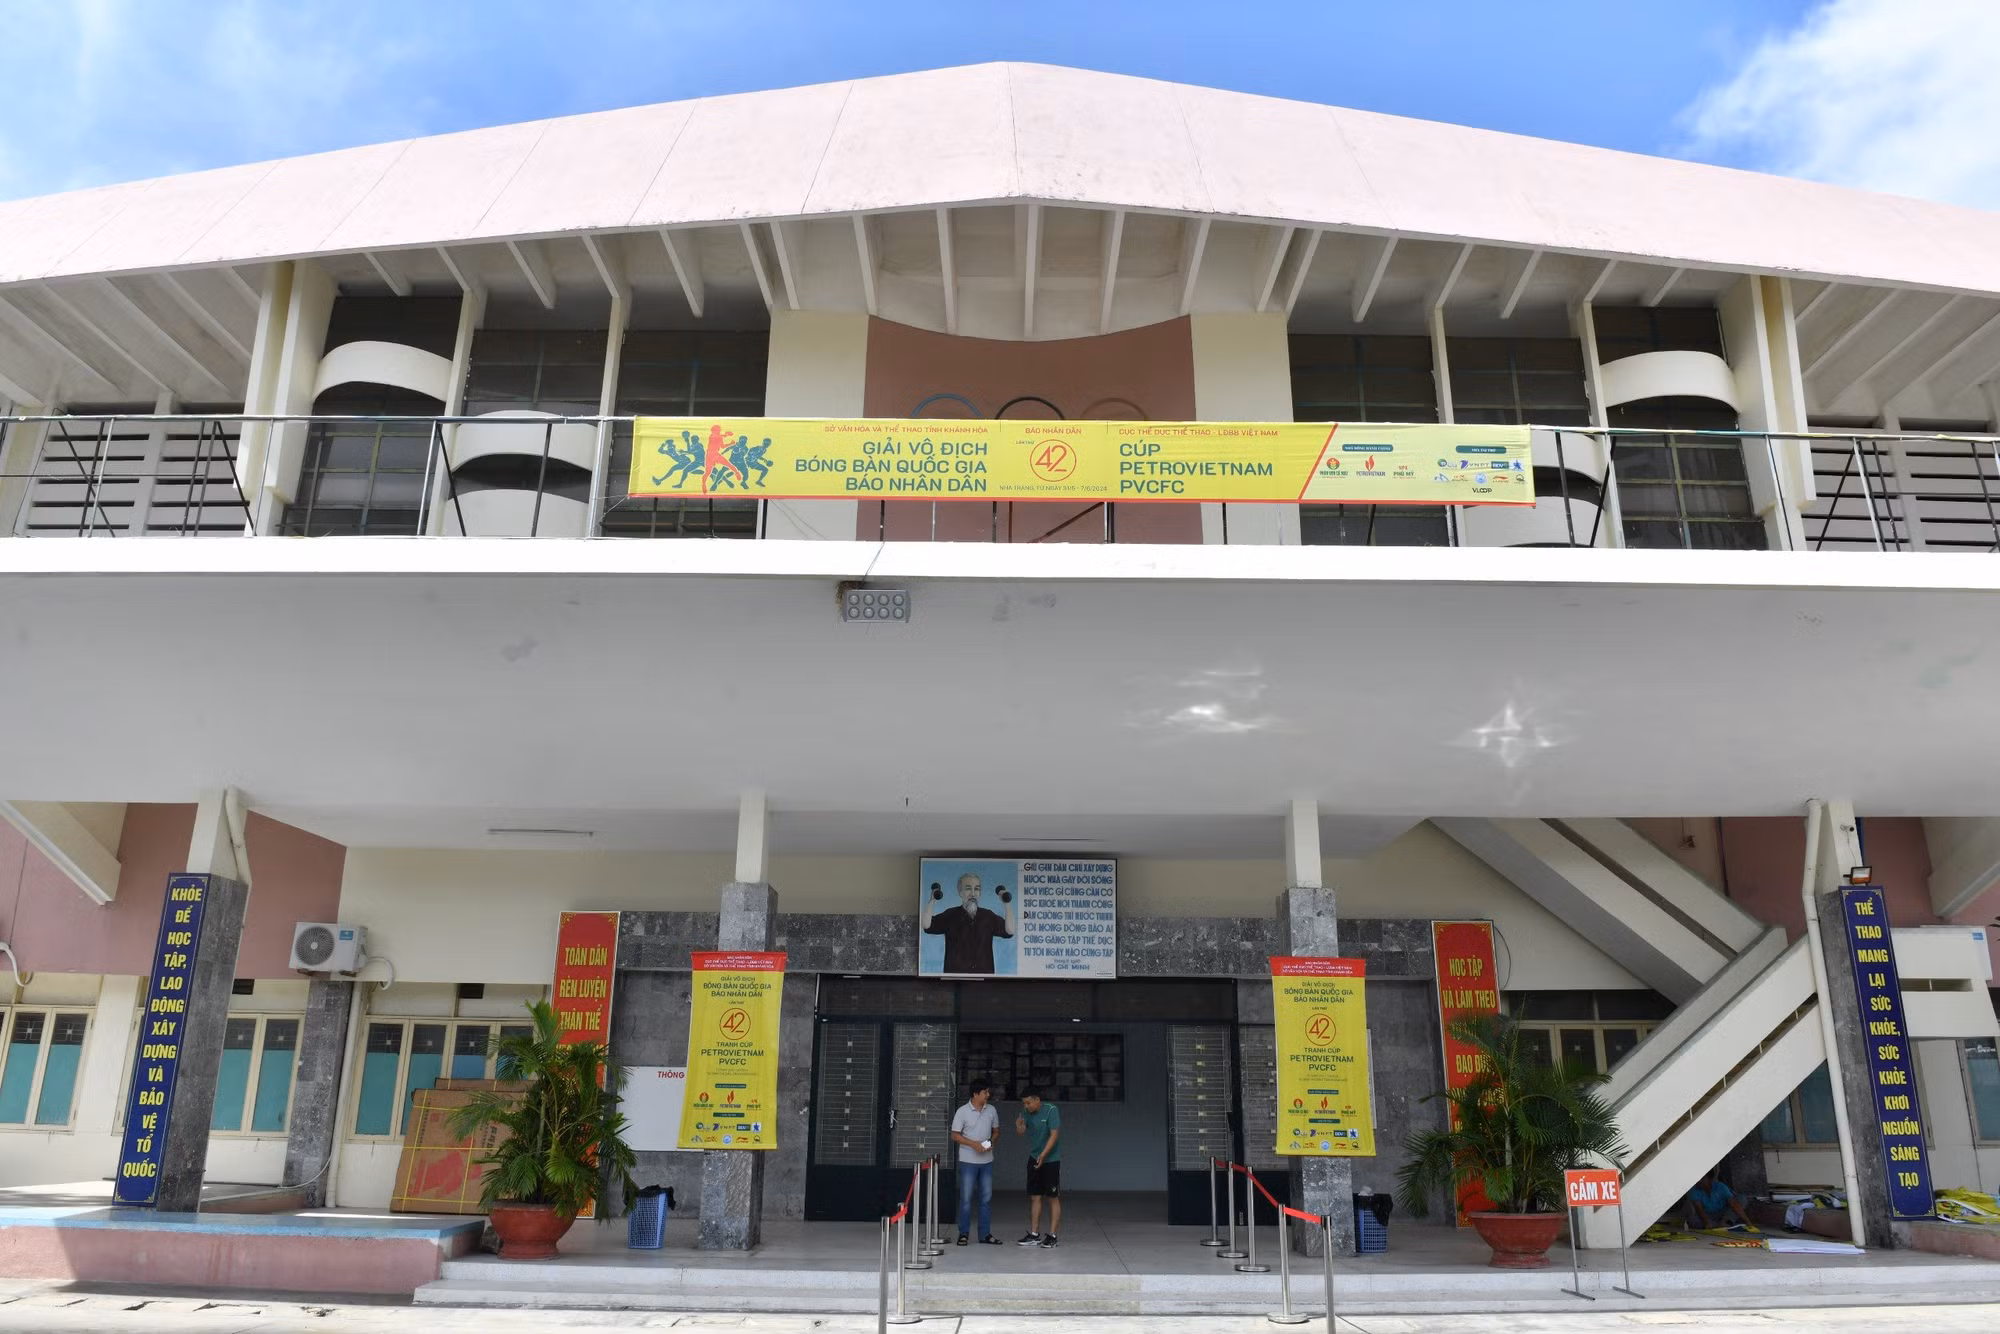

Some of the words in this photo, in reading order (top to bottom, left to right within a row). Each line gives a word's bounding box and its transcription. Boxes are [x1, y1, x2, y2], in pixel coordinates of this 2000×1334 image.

[1066, 427, 1082, 435] DÂN
[863, 437, 900, 455] GIẢI
[909, 438, 934, 456] VÔ
[940, 442, 988, 458] ĐỊCH
[1119, 440, 1162, 457] CÚP
[795, 455, 847, 472] BÓNG
[852, 456, 891, 473] BÀN
[896, 453, 950, 474] QUỐC
[955, 460, 987, 474] GIA
[1034, 444, 1068, 472] 42
[1120, 462, 1273, 476] PETROVIETNAM
[846, 474, 884, 491] BÁO
[889, 474, 942, 492] NHÂN
[948, 474, 987, 492] DÂN
[1120, 480, 1185, 494] PVCFC
[171, 884, 202, 902] KHỎE
[175, 905, 194, 924] ĐỂ
[1854, 896, 1875, 916] THỂ
[167, 931, 192, 948] HỌC
[1855, 925, 1882, 940] THAO
[164, 952, 187, 970] TẬP,
[565, 944, 588, 966] TOÀN
[588, 944, 608, 966] DÂN
[1857, 948, 1888, 963] MANG
[1449, 958, 1466, 981] HỌC
[1467, 954, 1482, 981] TẬP
[160, 976, 183, 990] LAO
[560, 976, 578, 998] RÈN
[578, 976, 607, 1002] LUYỆN
[1868, 972, 1886, 990] LẠI
[150, 996, 184, 1016] ĐỘNG
[1442, 986, 1454, 1008] VÀ
[1456, 986, 1474, 1008] LÀM
[1475, 990, 1496, 1008] THEO
[1870, 994, 1892, 1012] SỨC
[560, 1008, 583, 1030] THÂN
[585, 1004, 602, 1030] THỂ
[722, 1012, 746, 1033] 42
[151, 1018, 176, 1036] XÂY
[1309, 1018, 1330, 1039] 42
[1870, 1016, 1901, 1038] KHỎE,
[142, 1044, 176, 1062] DỰNG
[701, 1048, 764, 1056] PETROVIETNAM
[1290, 1054, 1354, 1062] PETROVIETNAM
[1878, 1042, 1900, 1060] SỨC
[719, 1058, 746, 1066] PVCFC
[1309, 1064, 1336, 1072] PVCFC
[1456, 1054, 1473, 1078] ĐẠO
[148, 1065, 164, 1082] VÀ
[1878, 1066, 1907, 1085] KHỎE
[139, 1087, 164, 1106] BẢO
[1884, 1095, 1910, 1110] KHƠI
[142, 1112, 158, 1132] VỆ
[1882, 1116, 1920, 1136] NGUỒN
[136, 1133, 153, 1154] TỔ
[1890, 1142, 1920, 1162] SÁNG
[122, 1158, 157, 1178] QUỐC
[1570, 1176, 1598, 1200] CẤM
[1600, 1181, 1617, 1200] XE
[1898, 1172, 1920, 1190] TẠO
